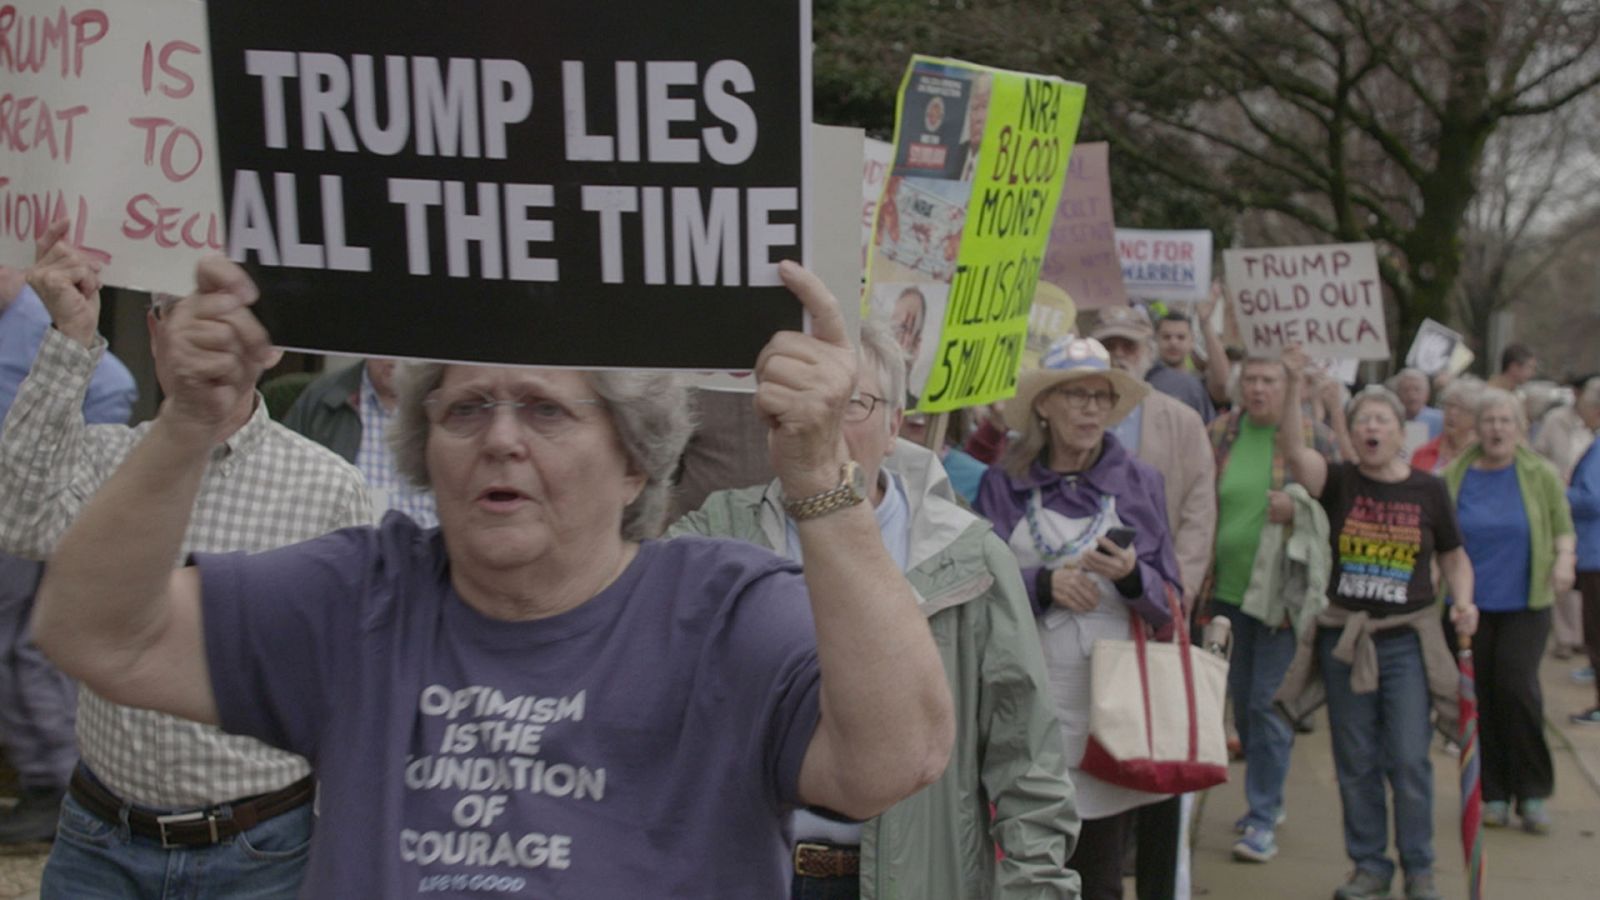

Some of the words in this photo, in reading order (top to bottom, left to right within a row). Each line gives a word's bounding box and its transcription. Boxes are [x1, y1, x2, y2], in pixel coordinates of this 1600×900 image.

[142, 40, 201, 99] IS
[245, 49, 534, 160] TRUMP
[562, 59, 758, 165] LIES
[1018, 78, 1062, 134] NRA
[129, 117, 202, 182] TO
[991, 125, 1060, 185] BLOOD
[228, 169, 372, 272] ALL
[388, 178, 559, 282] THE
[581, 185, 799, 287] TIME
[976, 187, 1049, 238] MONEY
[1119, 239, 1148, 262] NC
[1151, 239, 1195, 262] FOR
[1244, 250, 1351, 279] TRUMP
[1239, 285, 1310, 316] SOLD
[1319, 280, 1376, 309] OUT
[1252, 317, 1381, 348] AMERICA
[440, 722, 478, 754] IS
[452, 794, 508, 828] OF
[400, 828, 572, 869] COURAGE
